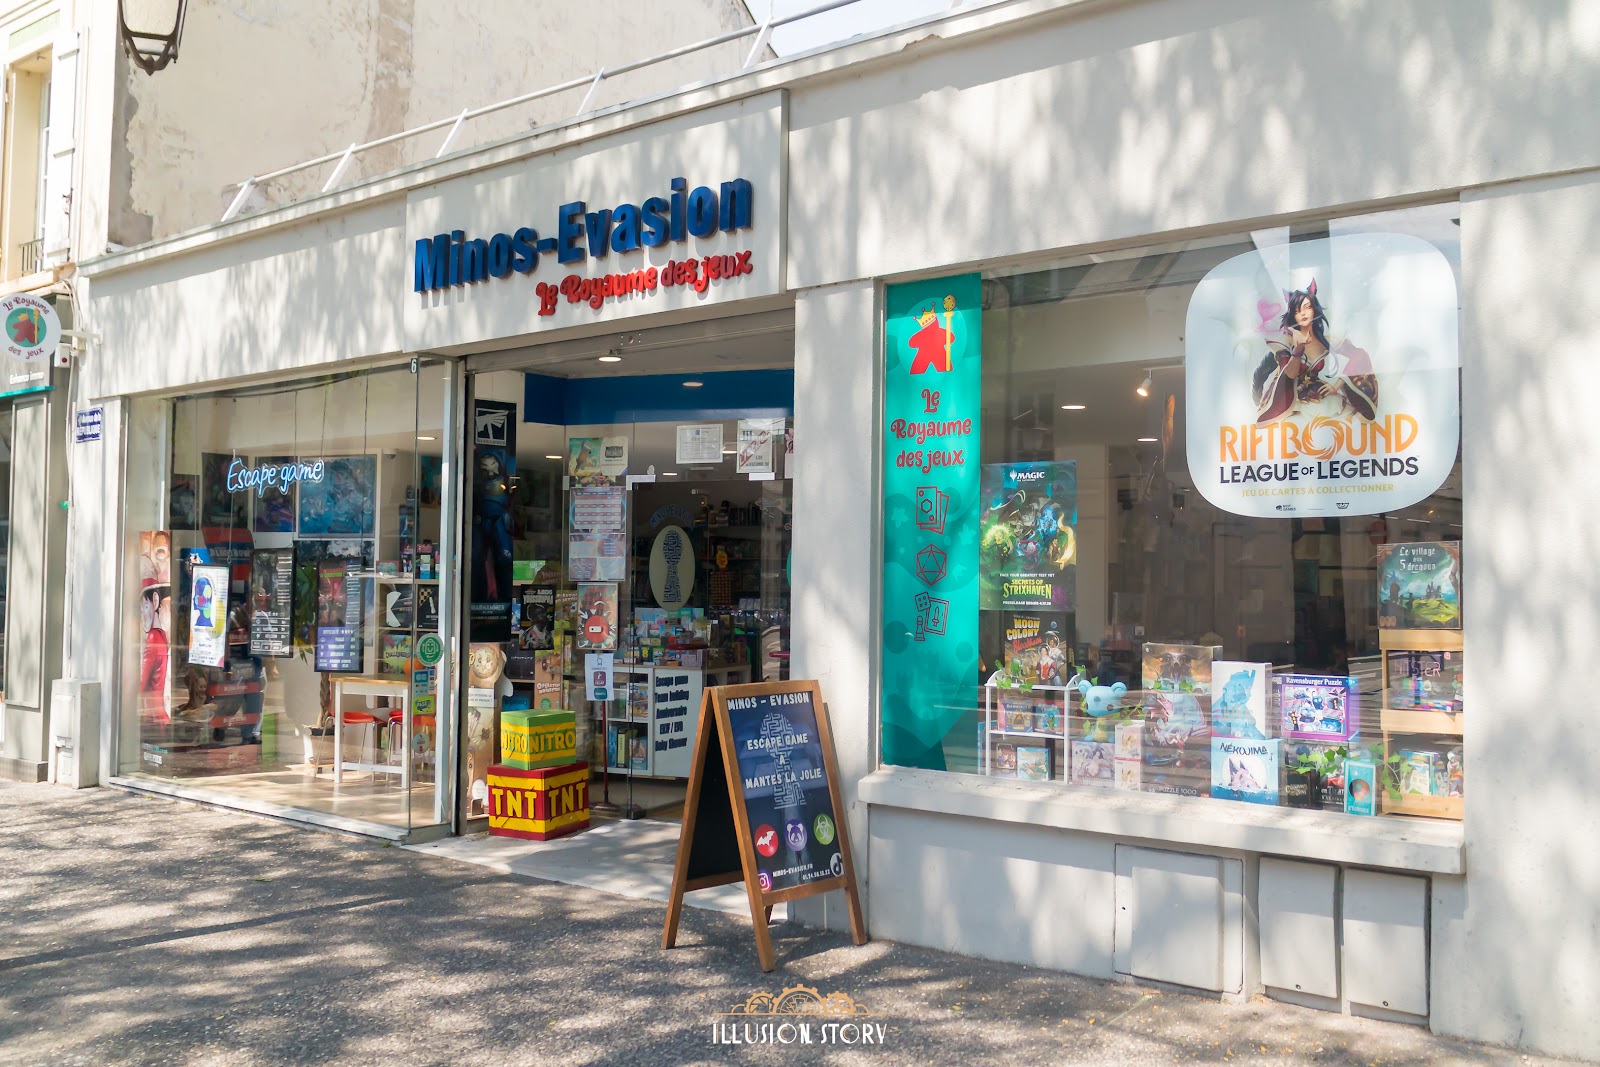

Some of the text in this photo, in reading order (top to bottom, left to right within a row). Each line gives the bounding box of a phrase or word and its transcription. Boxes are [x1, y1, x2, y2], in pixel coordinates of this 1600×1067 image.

[414, 177, 753, 293] Minos-Evasion
[535, 250, 753, 316] Le Royaume des jeux
[13, 296, 50, 315] Royaume
[411, 358, 417, 373] 6
[921, 387, 941, 414] Le
[890, 417, 972, 445] Royaume
[1219, 413, 1419, 463] RIFTBOUND
[896, 449, 965, 475] des jeux
[1219, 455, 1419, 484] LEAGUE OF LEGENDS
[227, 459, 322, 497] Escape game
[1016, 471, 1045, 480] MAGIC
[1242, 487, 1257, 497] JEU
[1258, 487, 1270, 497] DE
[1271, 486, 1306, 497] CARTES
[1316, 483, 1394, 495] COLLECTIONNER
[1399, 546, 1436, 557] Le village
[1407, 562, 1436, 572] dragons
[1003, 582, 1052, 600] STRIXHAVEN
[1013, 618, 1041, 629] MOON
[1006, 628, 1040, 641] COLONY
[1285, 676, 1324, 686] Ravensburger
[727, 698, 757, 711] MINOS
[769, 692, 810, 707] EVASION
[501, 731, 527, 753] NITRO
[529, 730, 576, 753] NITRO
[747, 733, 809, 751] ESCAPE GAME
[745, 767, 822, 789] MANTES LA JOLIE
[548, 781, 586, 818] TNT
[1158, 785, 1197, 796] PUZZLE 1000
[491, 787, 537, 819] TNT
